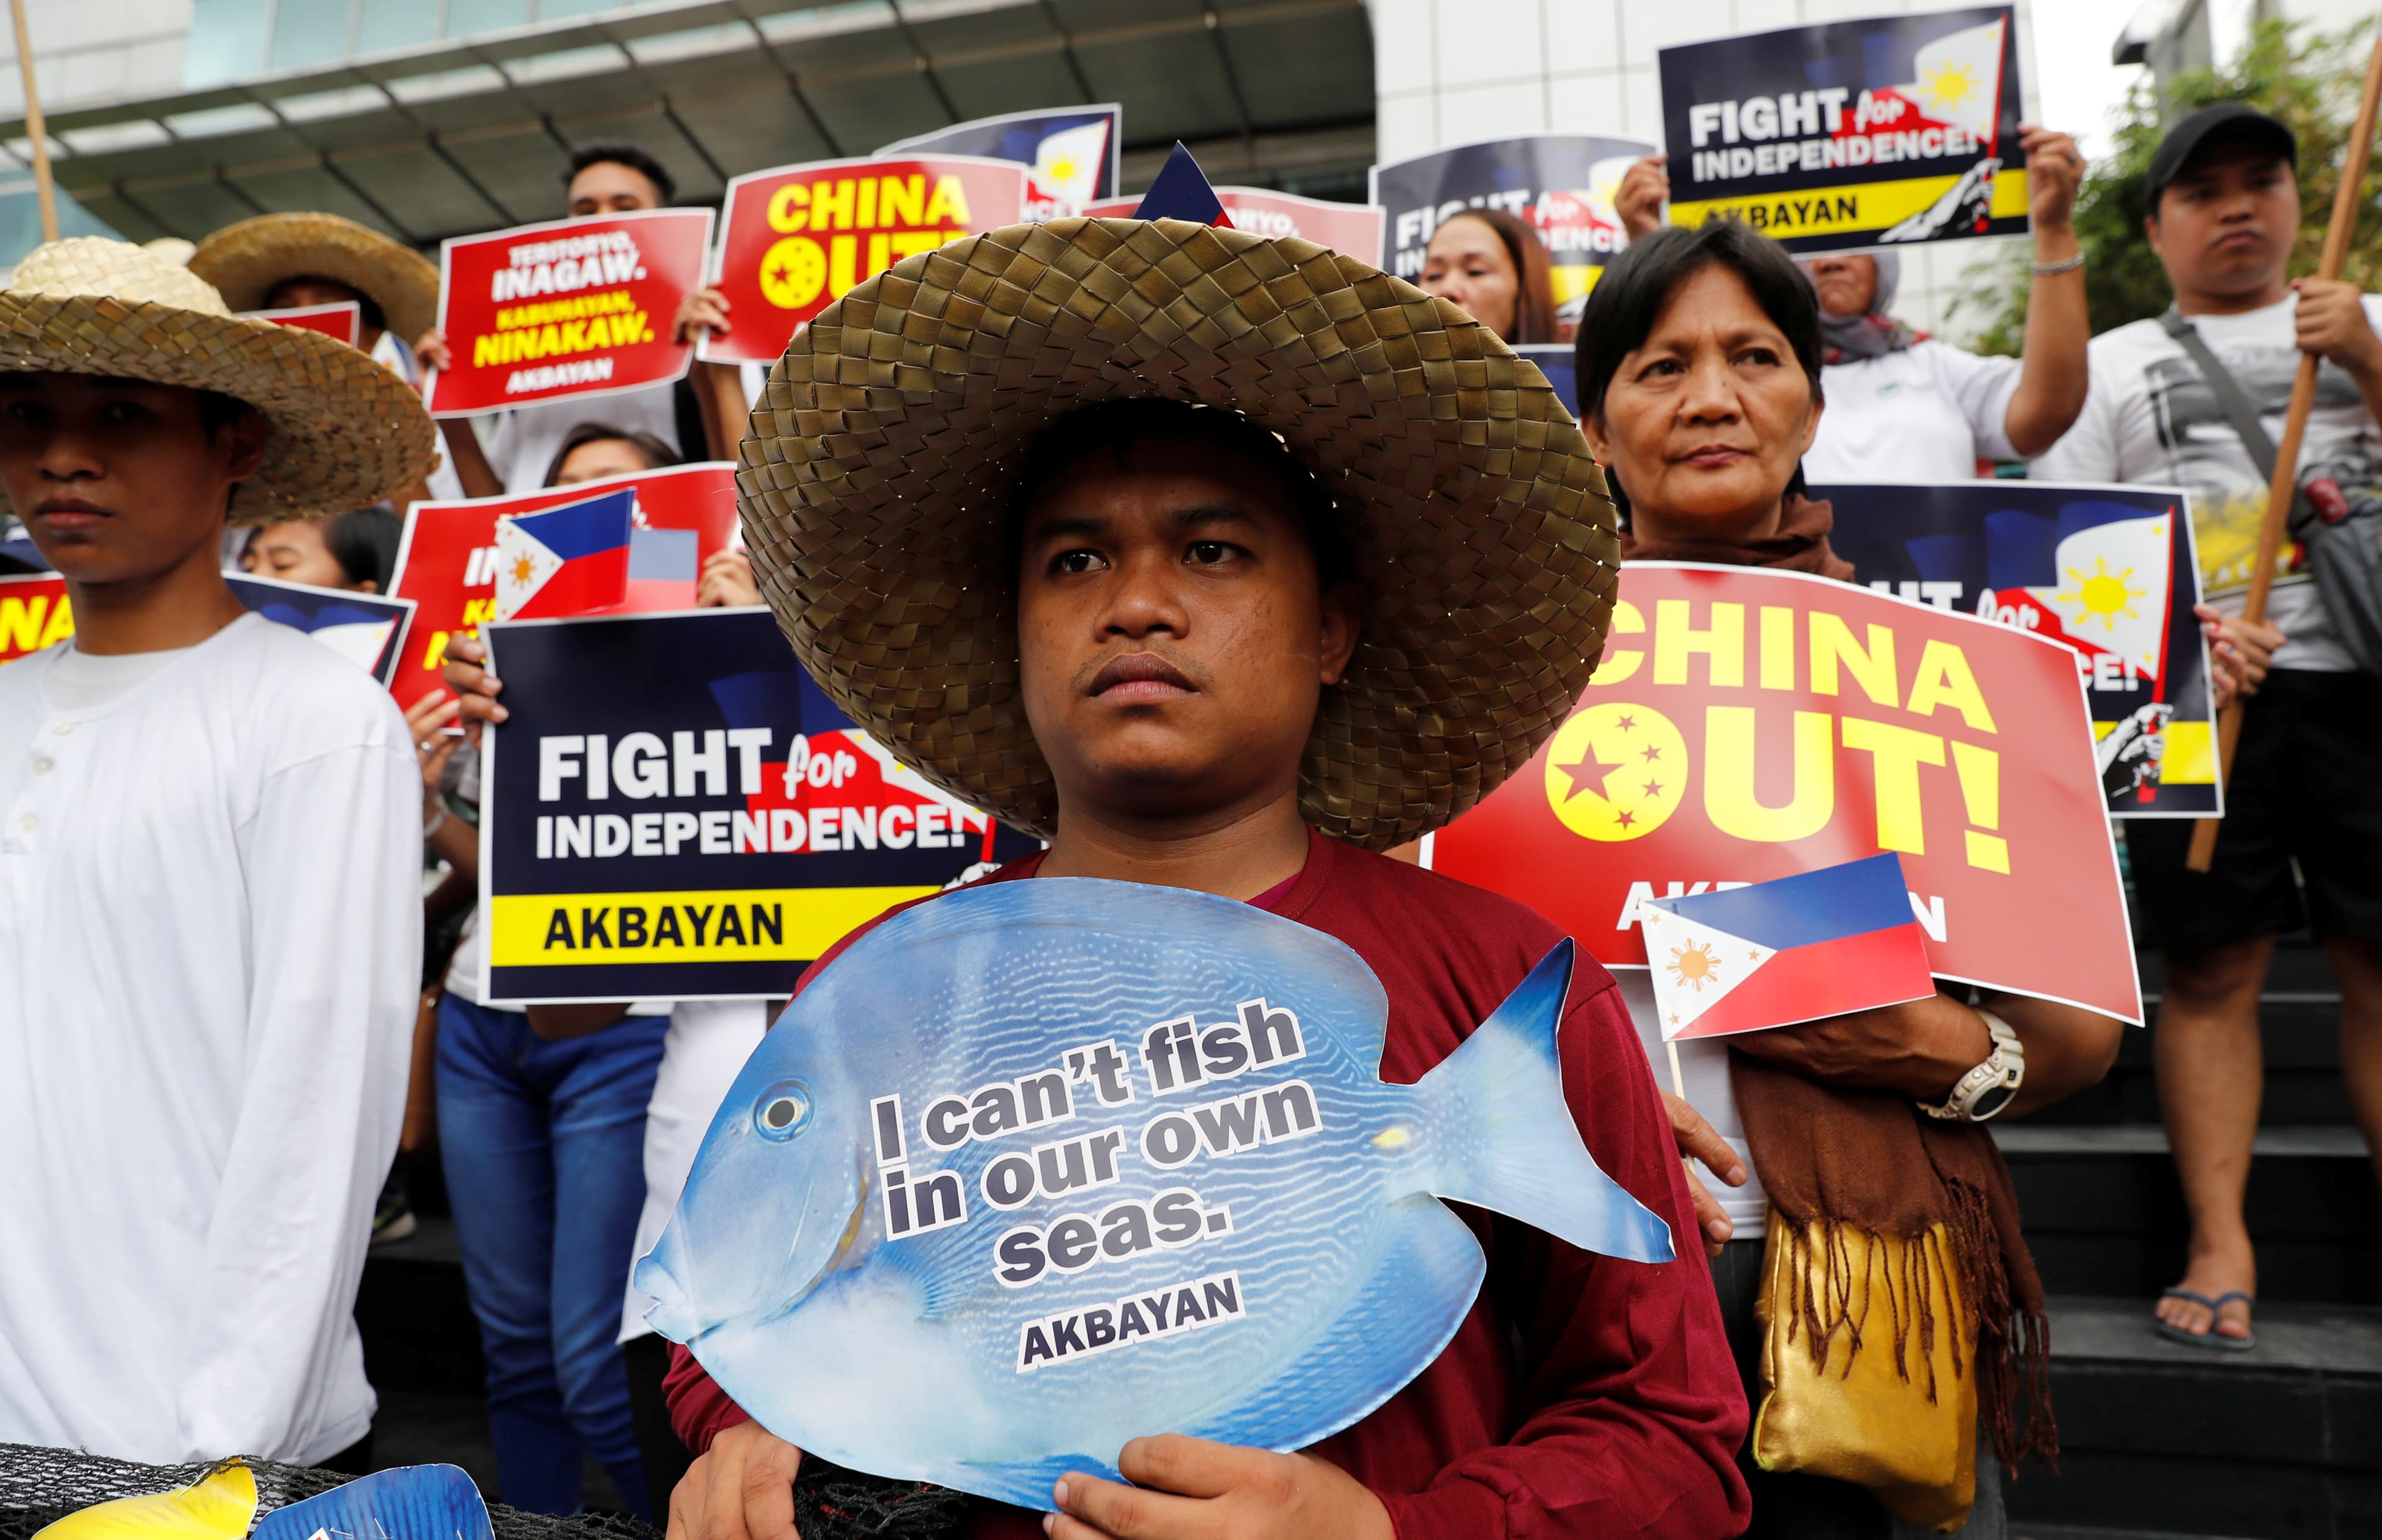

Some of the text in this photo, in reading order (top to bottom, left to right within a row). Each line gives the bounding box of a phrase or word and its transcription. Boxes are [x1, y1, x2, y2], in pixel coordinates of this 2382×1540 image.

[1689, 87, 1906, 146] FIGHT for
[1692, 127, 1978, 182] INDEPENDENCE!
[767, 175, 971, 233] CHINA
[491, 251, 647, 301] INAGAW.
[473, 311, 655, 368] NINAKAW.
[506, 358, 613, 393] AKBAYAN
[539, 728, 857, 801] FIGHT for
[1545, 702, 2010, 875] OUT!
[537, 806, 965, 859] INDEPENDENCE!
[543, 903, 783, 950] AKBAYAN
[876, 1100, 901, 1160] I
[1145, 1004, 1300, 1090] fish
[886, 1085, 1316, 1235] in our own
[999, 1193, 1228, 1282] seas.
[1024, 1278, 1239, 1367] AKBAYAN
